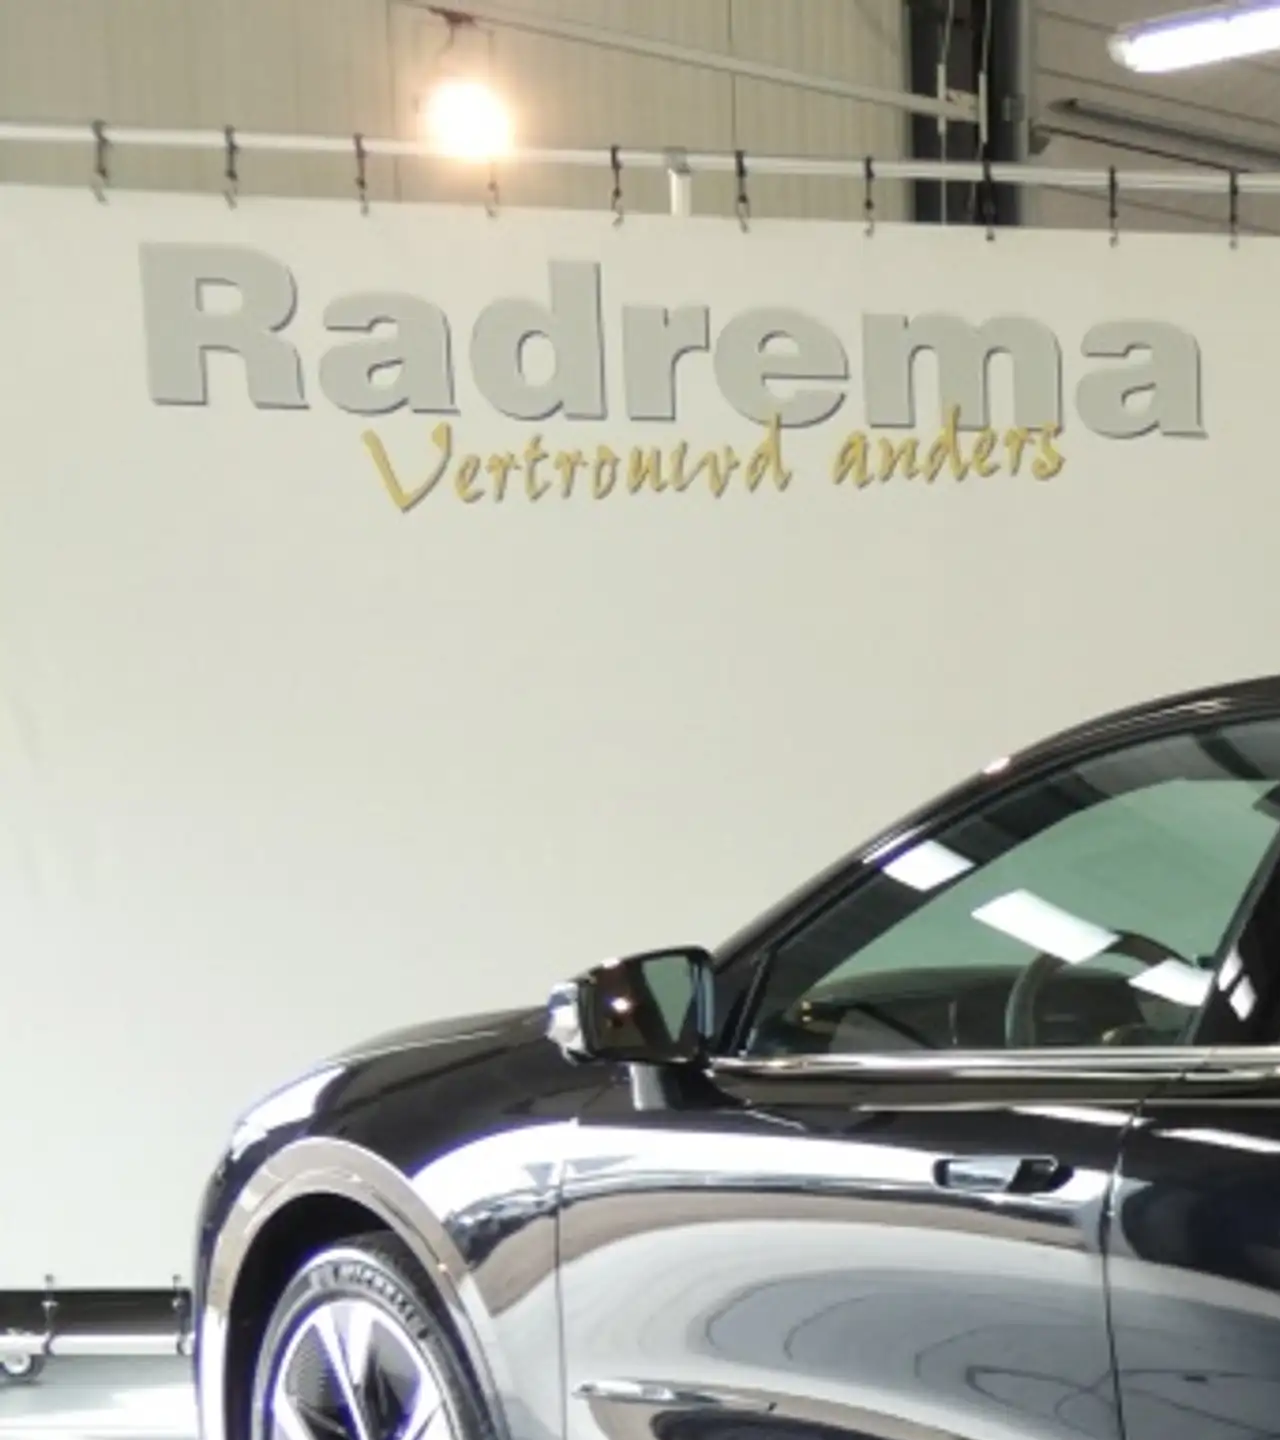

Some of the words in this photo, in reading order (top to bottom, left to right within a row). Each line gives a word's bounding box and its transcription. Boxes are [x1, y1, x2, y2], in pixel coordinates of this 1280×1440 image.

[138, 241, 1208, 439] Radrema
[361, 411, 793, 513] Vertrouwd
[831, 403, 1066, 491] anders
